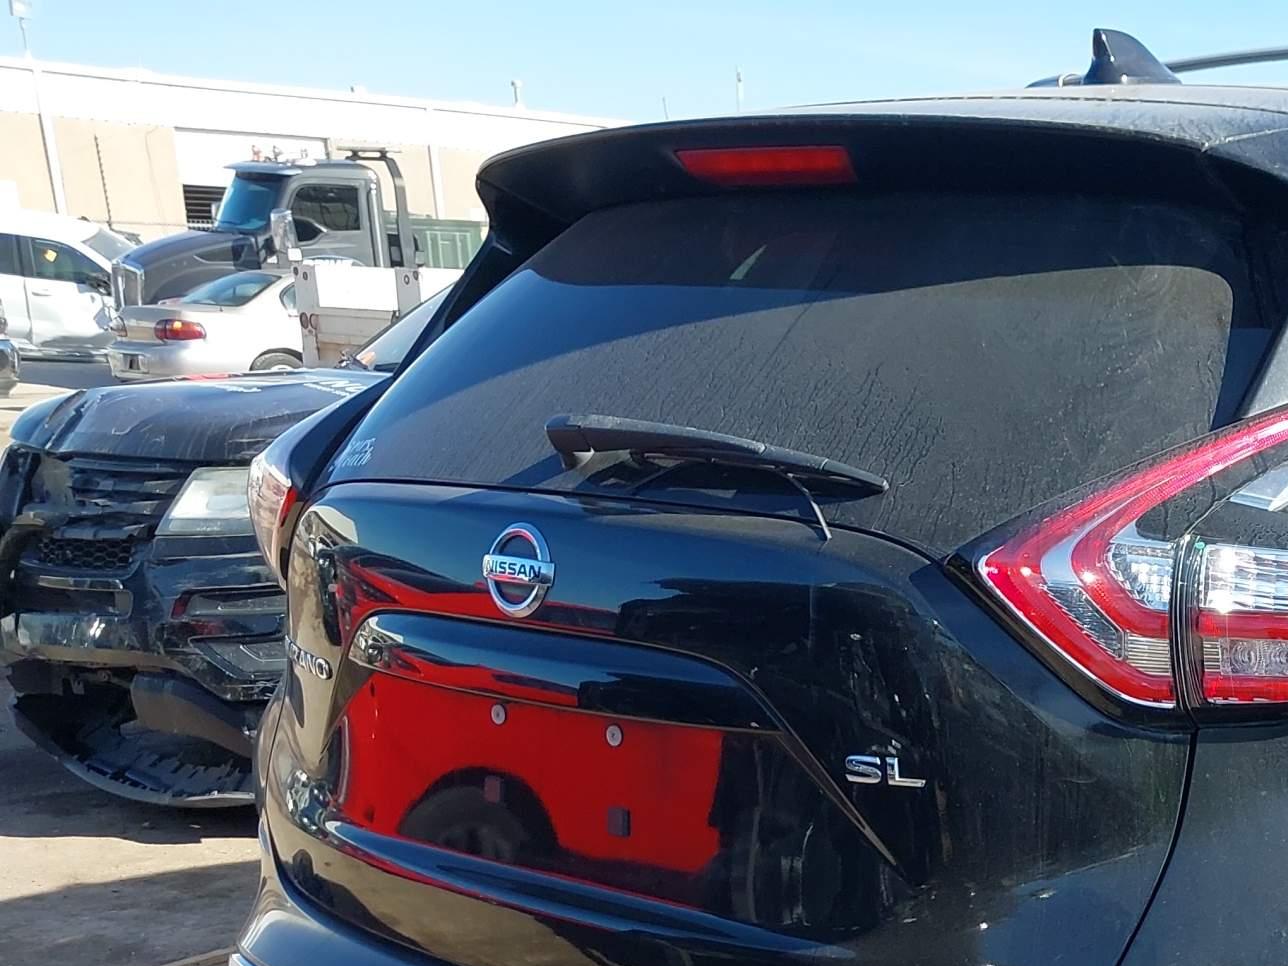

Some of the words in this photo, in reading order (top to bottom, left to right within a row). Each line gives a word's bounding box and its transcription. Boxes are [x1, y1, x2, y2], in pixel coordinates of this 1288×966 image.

[485, 559, 542, 579] NISSAN
[286, 637, 331, 680] RANO
[845, 755, 927, 788] SL
